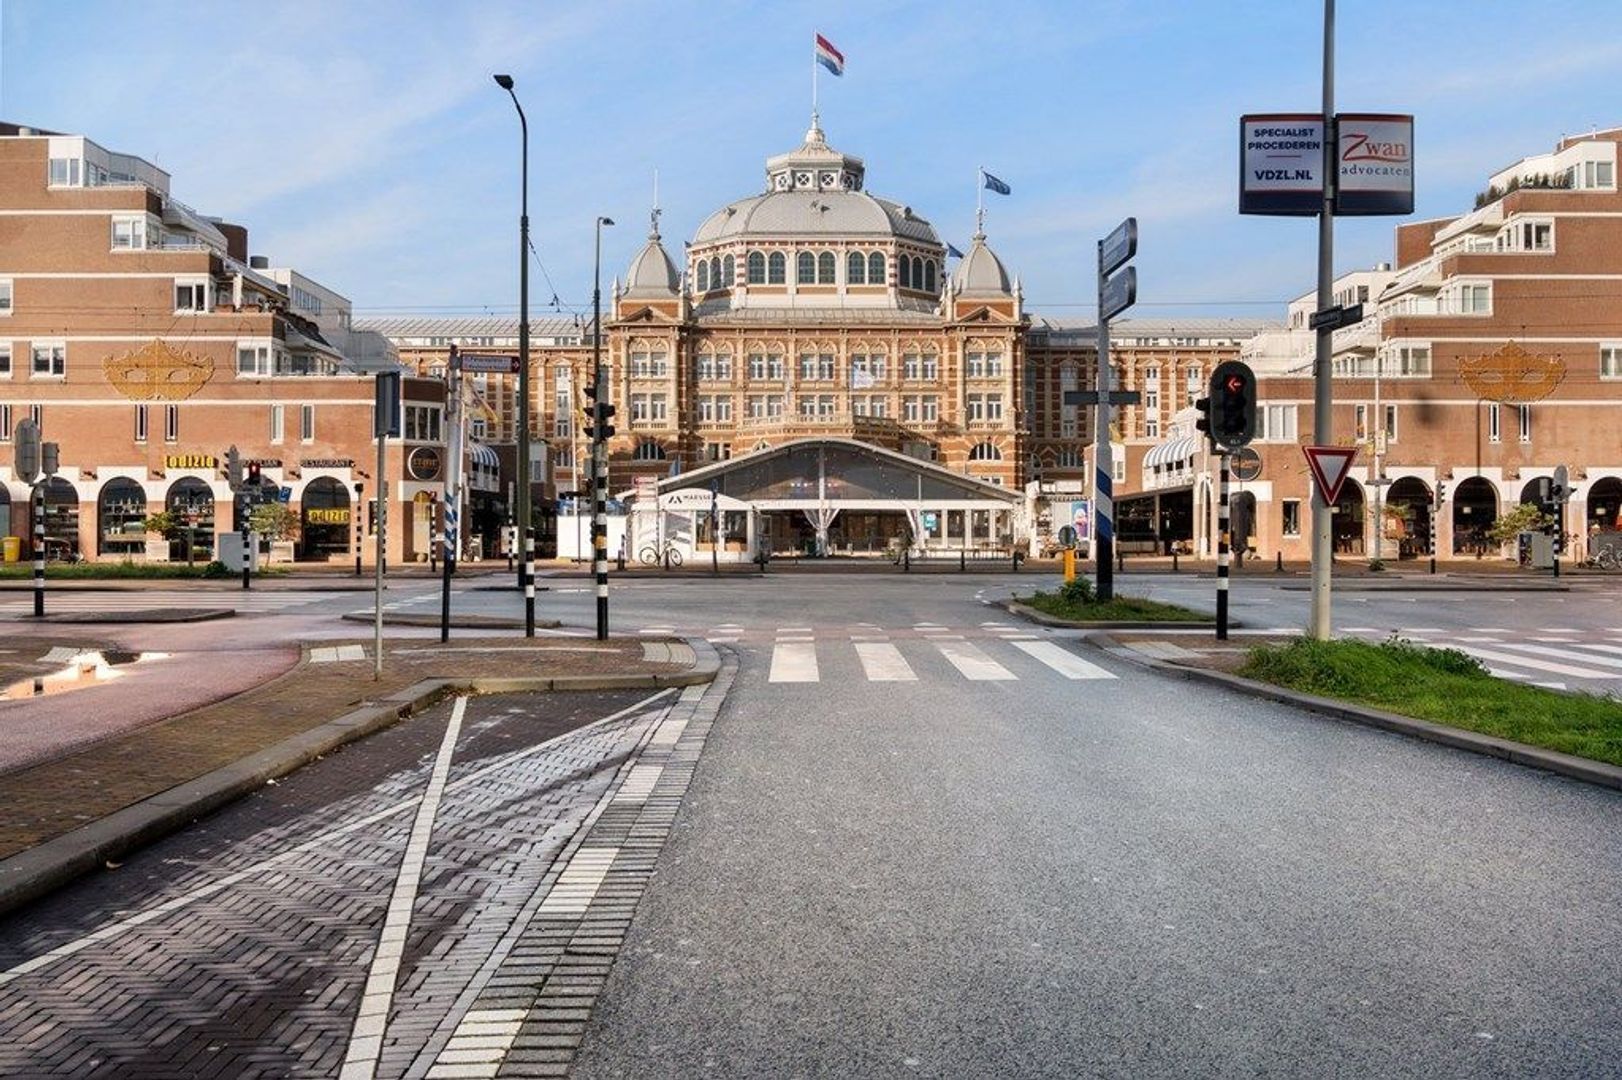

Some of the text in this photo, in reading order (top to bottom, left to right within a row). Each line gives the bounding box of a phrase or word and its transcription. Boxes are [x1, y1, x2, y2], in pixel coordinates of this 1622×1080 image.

[1254, 128, 1314, 137] SPECIALIST
[1248, 140, 1320, 150] PROCEDEREN
[1342, 134, 1409, 162] Zwan
[1254, 170, 1313, 180] VDZL.NL
[1341, 164, 1410, 176] advocaten
